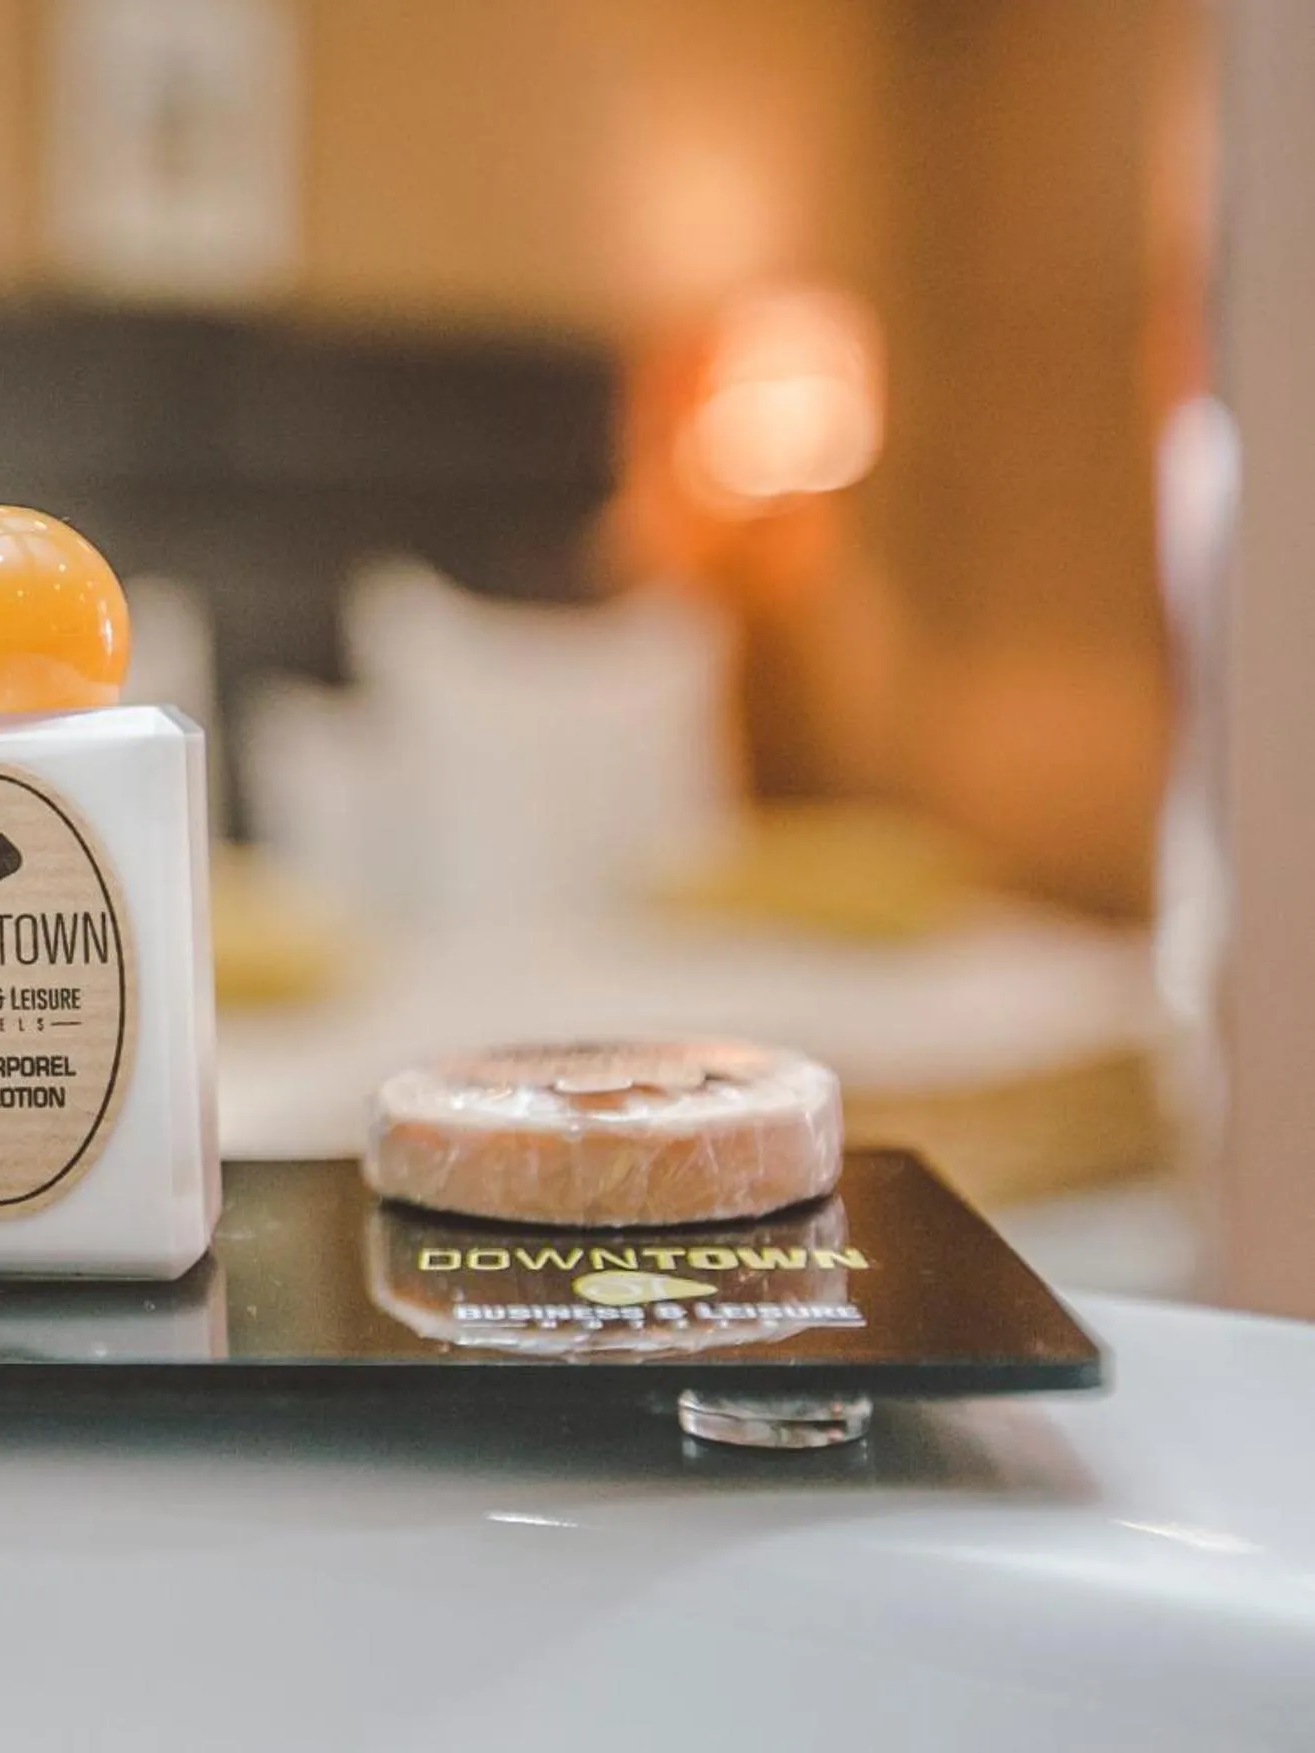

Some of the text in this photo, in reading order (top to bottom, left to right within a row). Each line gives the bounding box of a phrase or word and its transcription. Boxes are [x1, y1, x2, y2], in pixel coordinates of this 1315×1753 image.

[10, 985, 81, 1010] LEISURE
[419, 1247, 869, 1271] DOWNTOWN
[454, 1303, 645, 1321] BUSINESS
